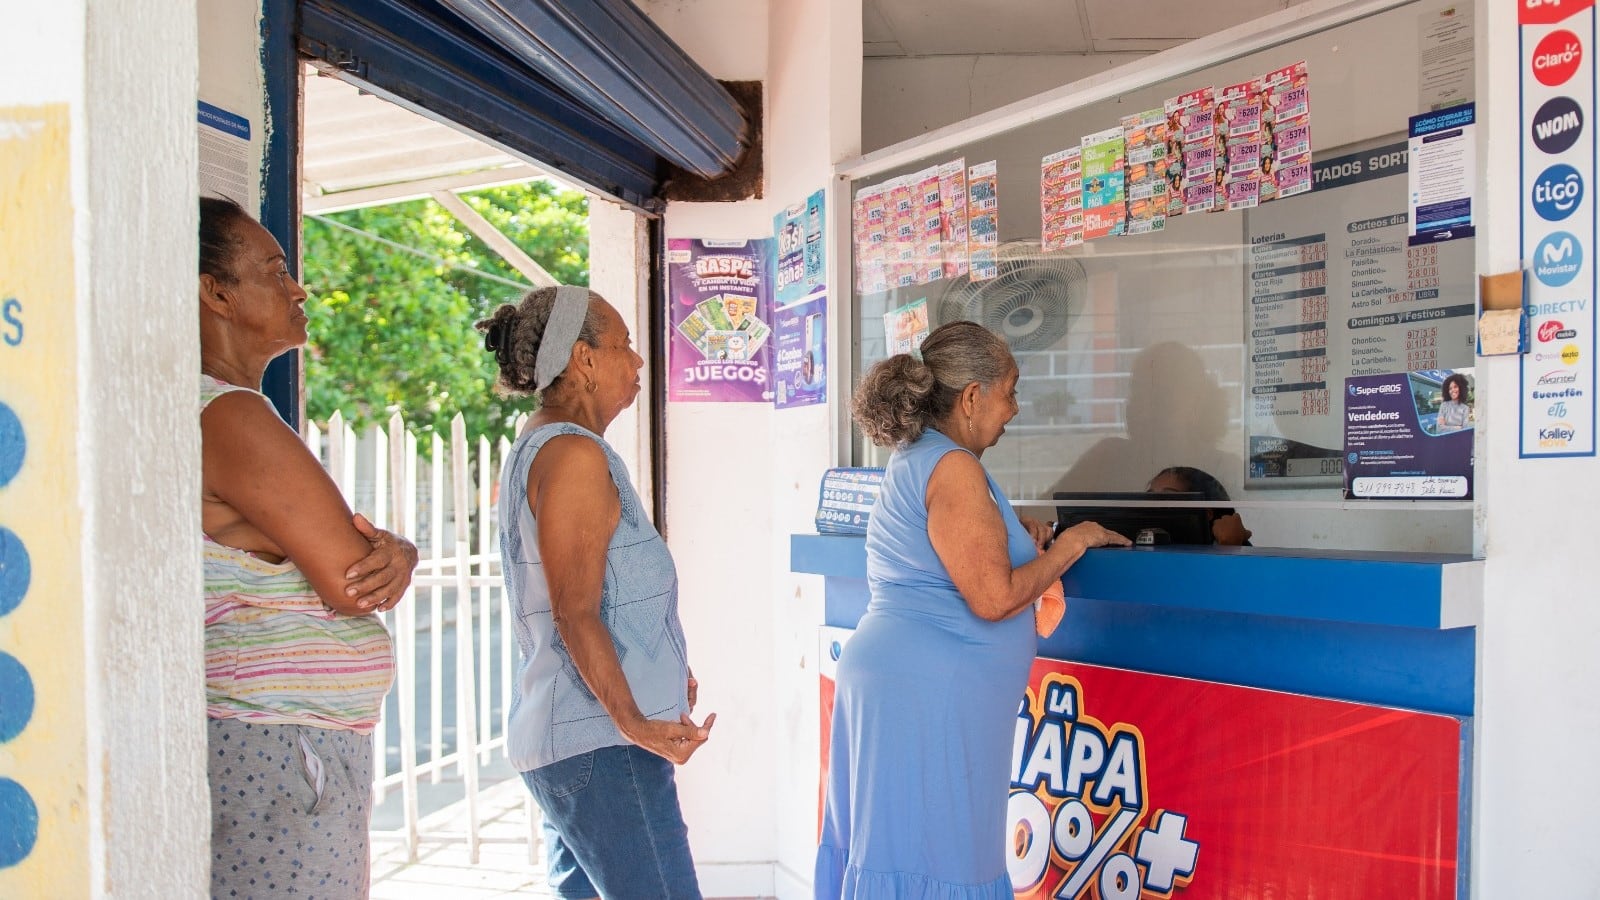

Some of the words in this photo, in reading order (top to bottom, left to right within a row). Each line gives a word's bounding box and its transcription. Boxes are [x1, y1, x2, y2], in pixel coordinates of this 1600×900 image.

[1535, 51, 1573, 69] Claro
[1536, 110, 1579, 140] WOM
[1290, 127, 1306, 139] 5374
[1292, 166, 1308, 178] 5374
[1313, 160, 1362, 184] TADOS
[1240, 182, 1257, 192] 6203
[1535, 178, 1579, 208] tigo
[1351, 220, 1388, 232] Sorteos
[1351, 236, 1376, 246] Dorado
[1345, 250, 1354, 258] La
[696, 257, 753, 278] RASPA
[1351, 257, 1374, 268] Paisita
[1351, 267, 1380, 278] Chontico
[1538, 263, 1578, 276] Movistar
[1254, 280, 1268, 288] Cruz
[1351, 290, 1360, 298] La
[1351, 300, 1370, 308] Astro
[1371, 298, 1382, 306] Sol
[1418, 290, 1436, 298] LIBRA
[1528, 299, 1587, 317] DIRECTV
[3, 297, 23, 347] S
[1352, 314, 1396, 326] Domingos
[1406, 309, 1446, 320] Festivos
[1352, 336, 1381, 345] Chontico
[1406, 338, 1435, 350] 0122
[1352, 358, 1360, 366] La
[1352, 368, 1381, 376] Chontico
[1537, 371, 1577, 385] Avantel
[1356, 384, 1402, 396] SuperGIROS
[1348, 410, 1400, 422] Vendedores
[1539, 428, 1575, 441] Kalley
[1050, 687, 1074, 717] LA
